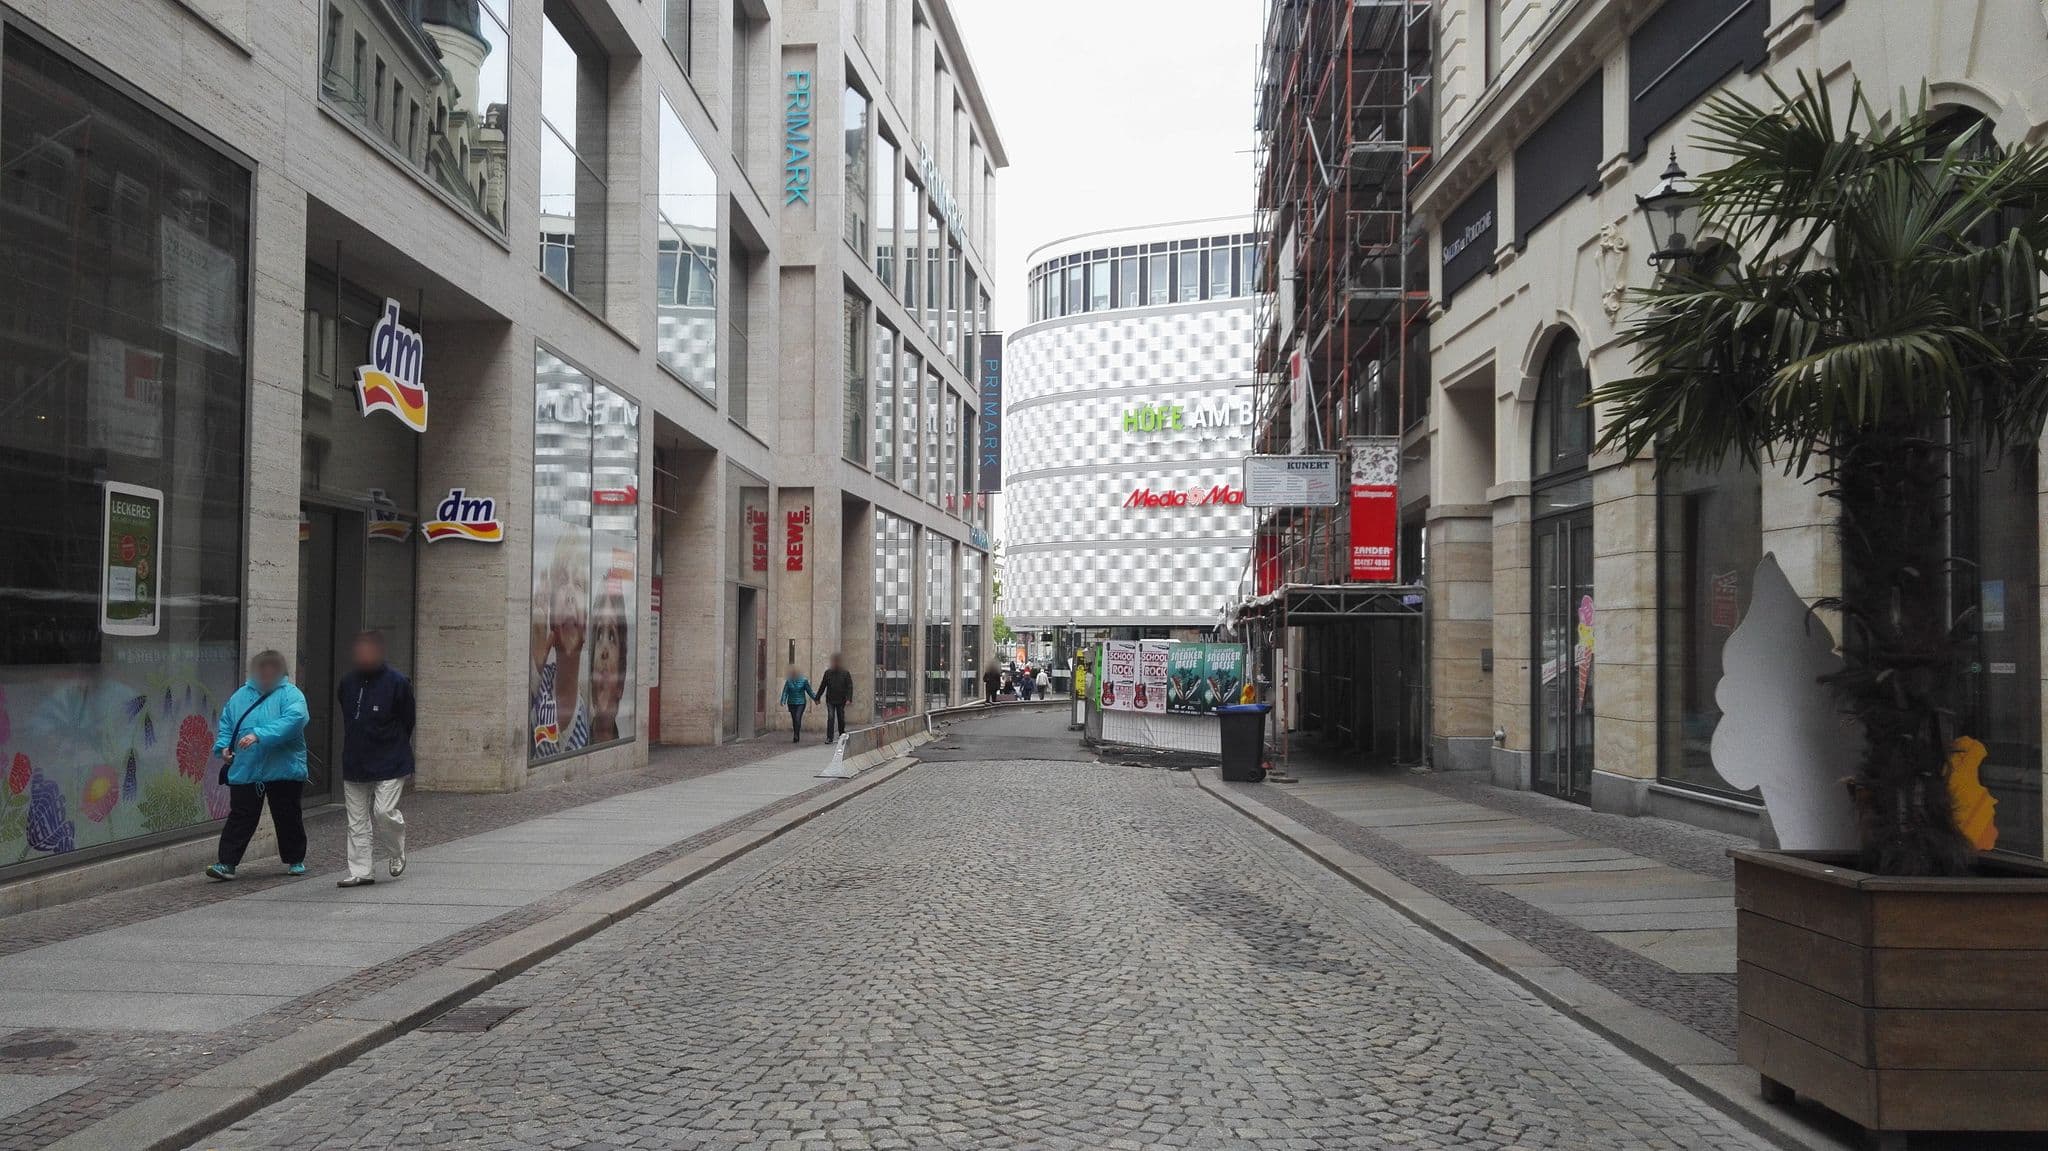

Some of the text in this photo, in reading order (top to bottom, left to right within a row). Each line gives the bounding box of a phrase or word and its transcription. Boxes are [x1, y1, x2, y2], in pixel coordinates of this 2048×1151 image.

[785, 71, 810, 206] PRIMARK
[376, 304, 421, 386] dm
[984, 359, 998, 466] PRIMARK
[1123, 402, 1184, 432] HÖFE
[1192, 403, 1230, 428] AM
[1287, 461, 1330, 470] KUNERT
[439, 491, 493, 522] dm
[1123, 488, 1188, 508] Media
[112, 500, 151, 519] LECKERES
[786, 510, 804, 572] REWE
[1353, 546, 1390, 555] ZANDER
[1171, 650, 1203, 661] SNEAKER
[1207, 651, 1241, 662] SNEAKER
[1112, 664, 1133, 675] ROCK
[1144, 665, 1168, 677] ROCK
[1212, 661, 1235, 671] MESSE
